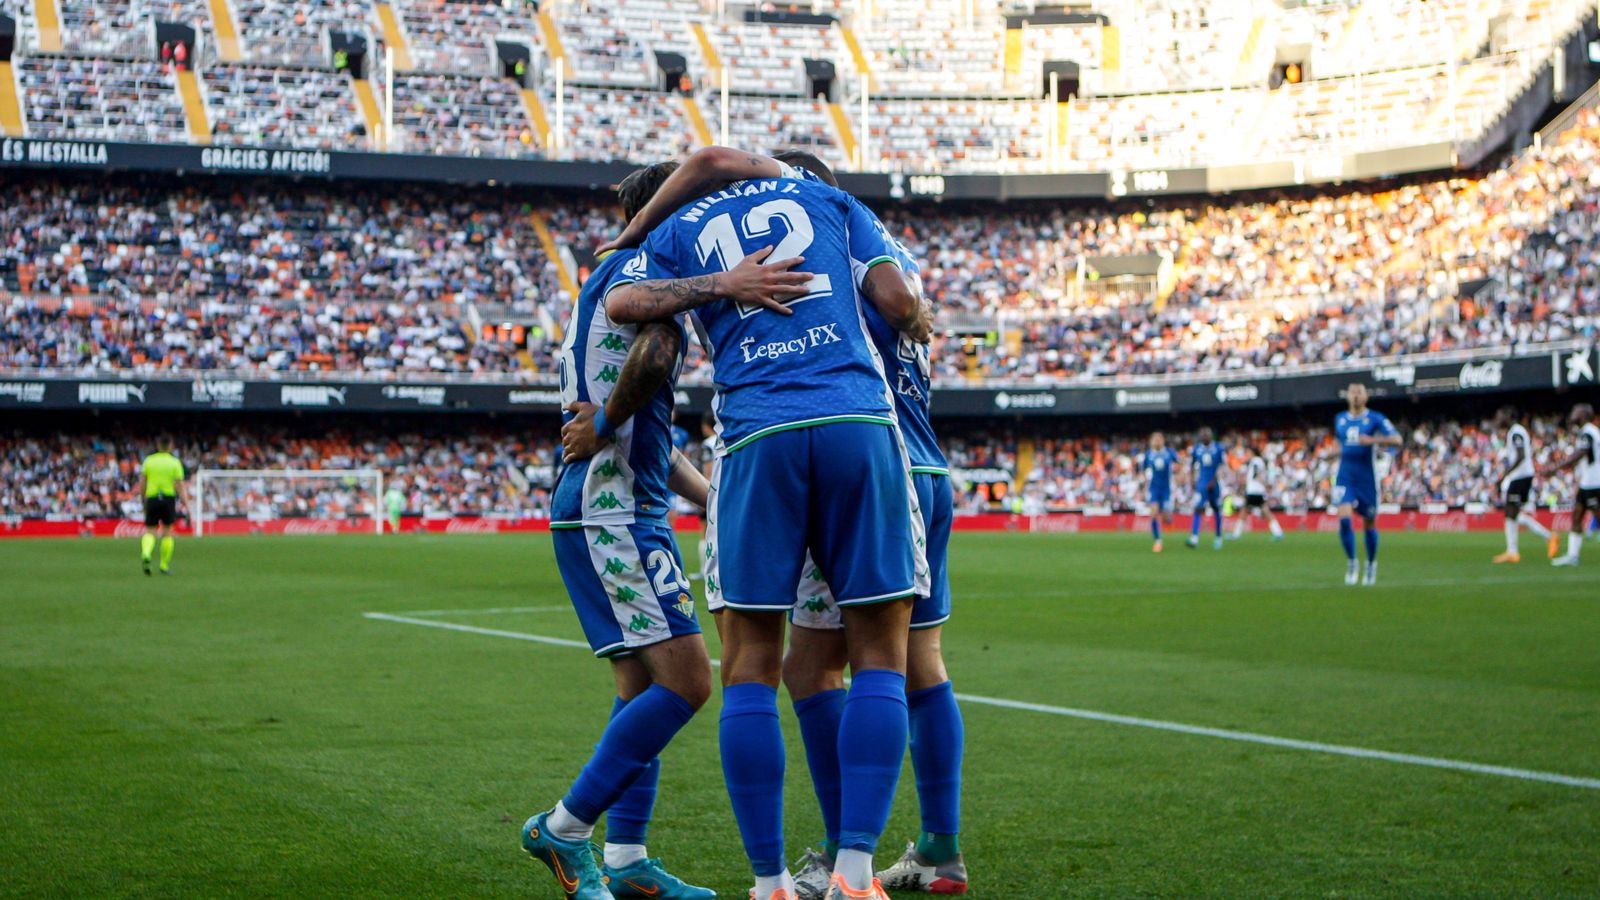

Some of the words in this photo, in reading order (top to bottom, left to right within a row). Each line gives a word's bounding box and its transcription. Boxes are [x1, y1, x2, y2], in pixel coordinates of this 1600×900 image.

[29, 141, 108, 164] MESTALLA
[201, 147, 268, 169] GRÀCIES
[272, 149, 331, 172] AFICIÓ!
[680, 180, 778, 222] WILLIAN
[695, 198, 833, 320] 12
[740, 322, 842, 364] LegacyFX
[78, 383, 128, 403] PUMA
[281, 386, 329, 405] PUMA
